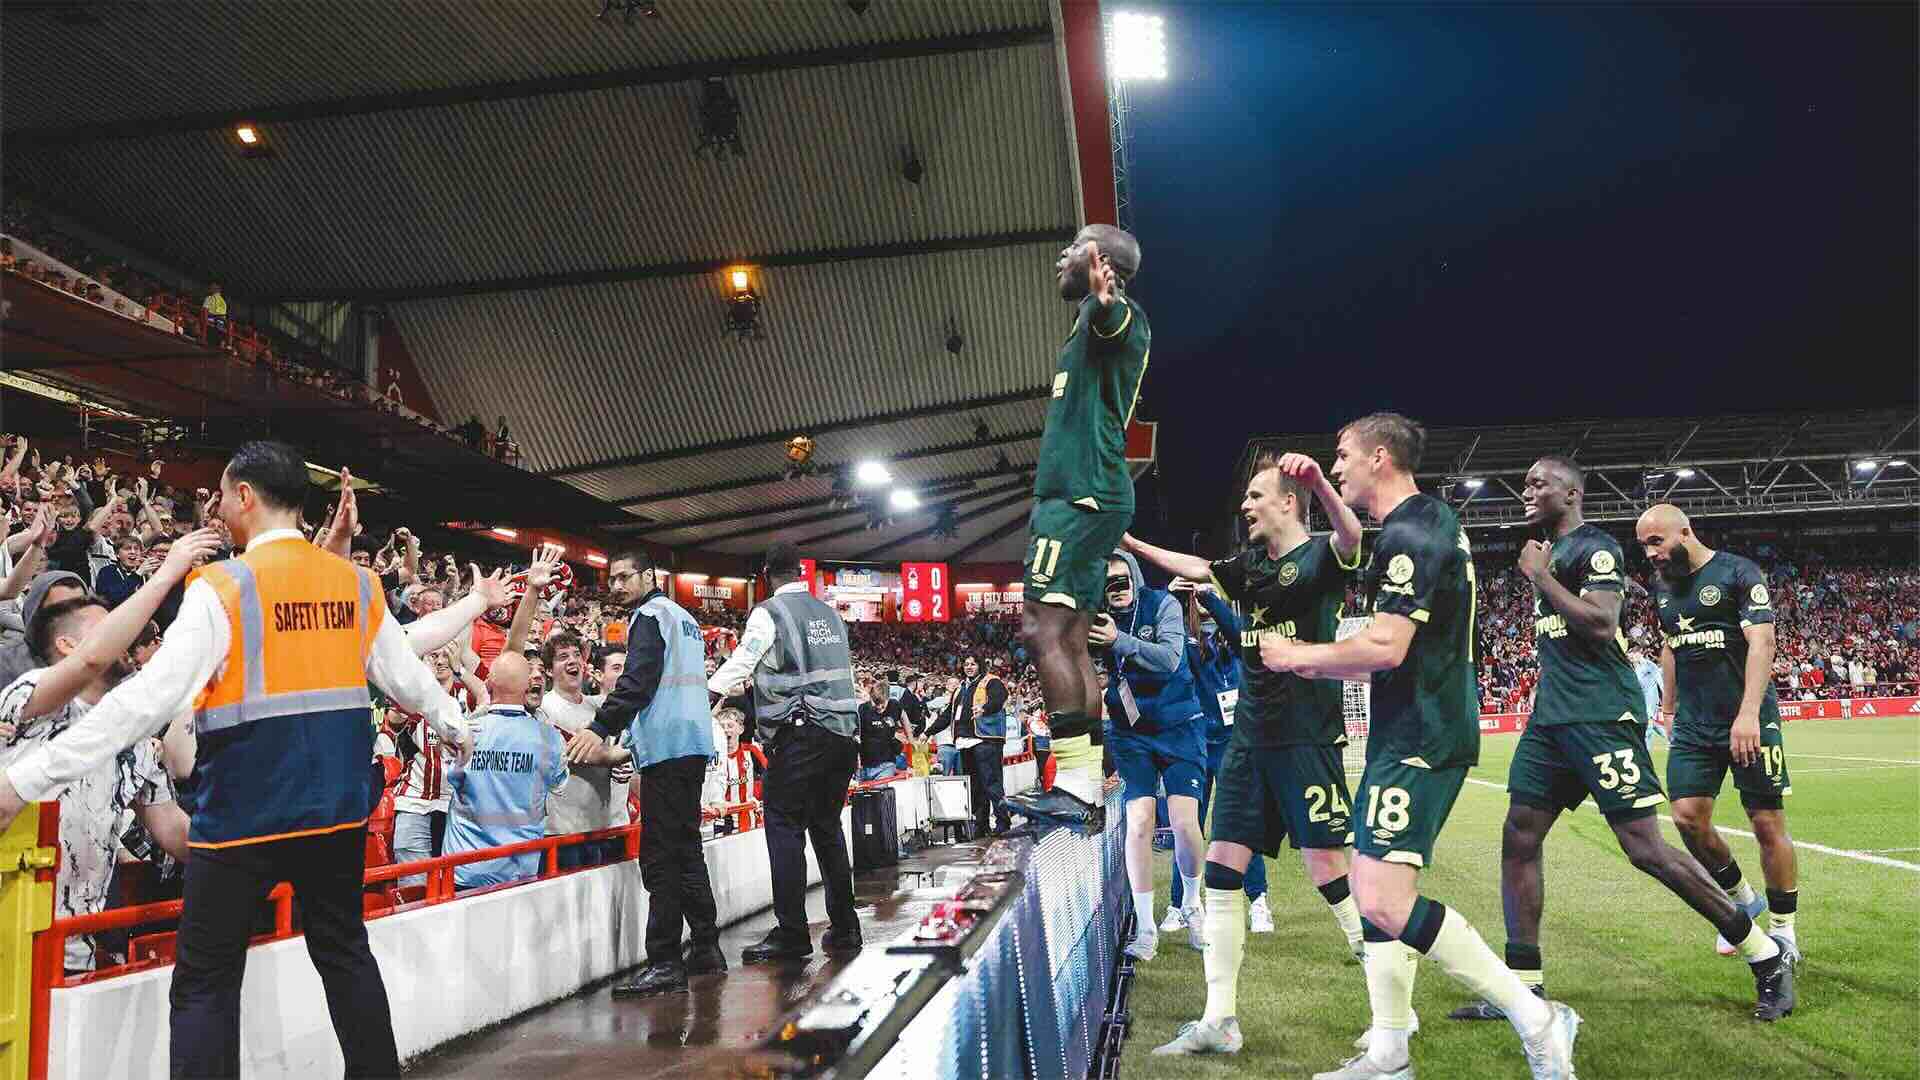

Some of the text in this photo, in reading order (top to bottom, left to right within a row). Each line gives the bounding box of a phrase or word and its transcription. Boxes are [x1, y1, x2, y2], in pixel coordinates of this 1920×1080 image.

[1032, 538, 1062, 577] 11
[931, 567, 941, 590] 0
[932, 594, 942, 617] 2
[983, 592, 1001, 602] CITY
[274, 601, 354, 632] SAFETY TEAM
[471, 751, 534, 774] RESPONSE TEAM
[1592, 749, 1641, 790] 33
[1760, 745, 1784, 776] 19
[1304, 783, 1351, 823] 24
[1366, 785, 1411, 832] 18
